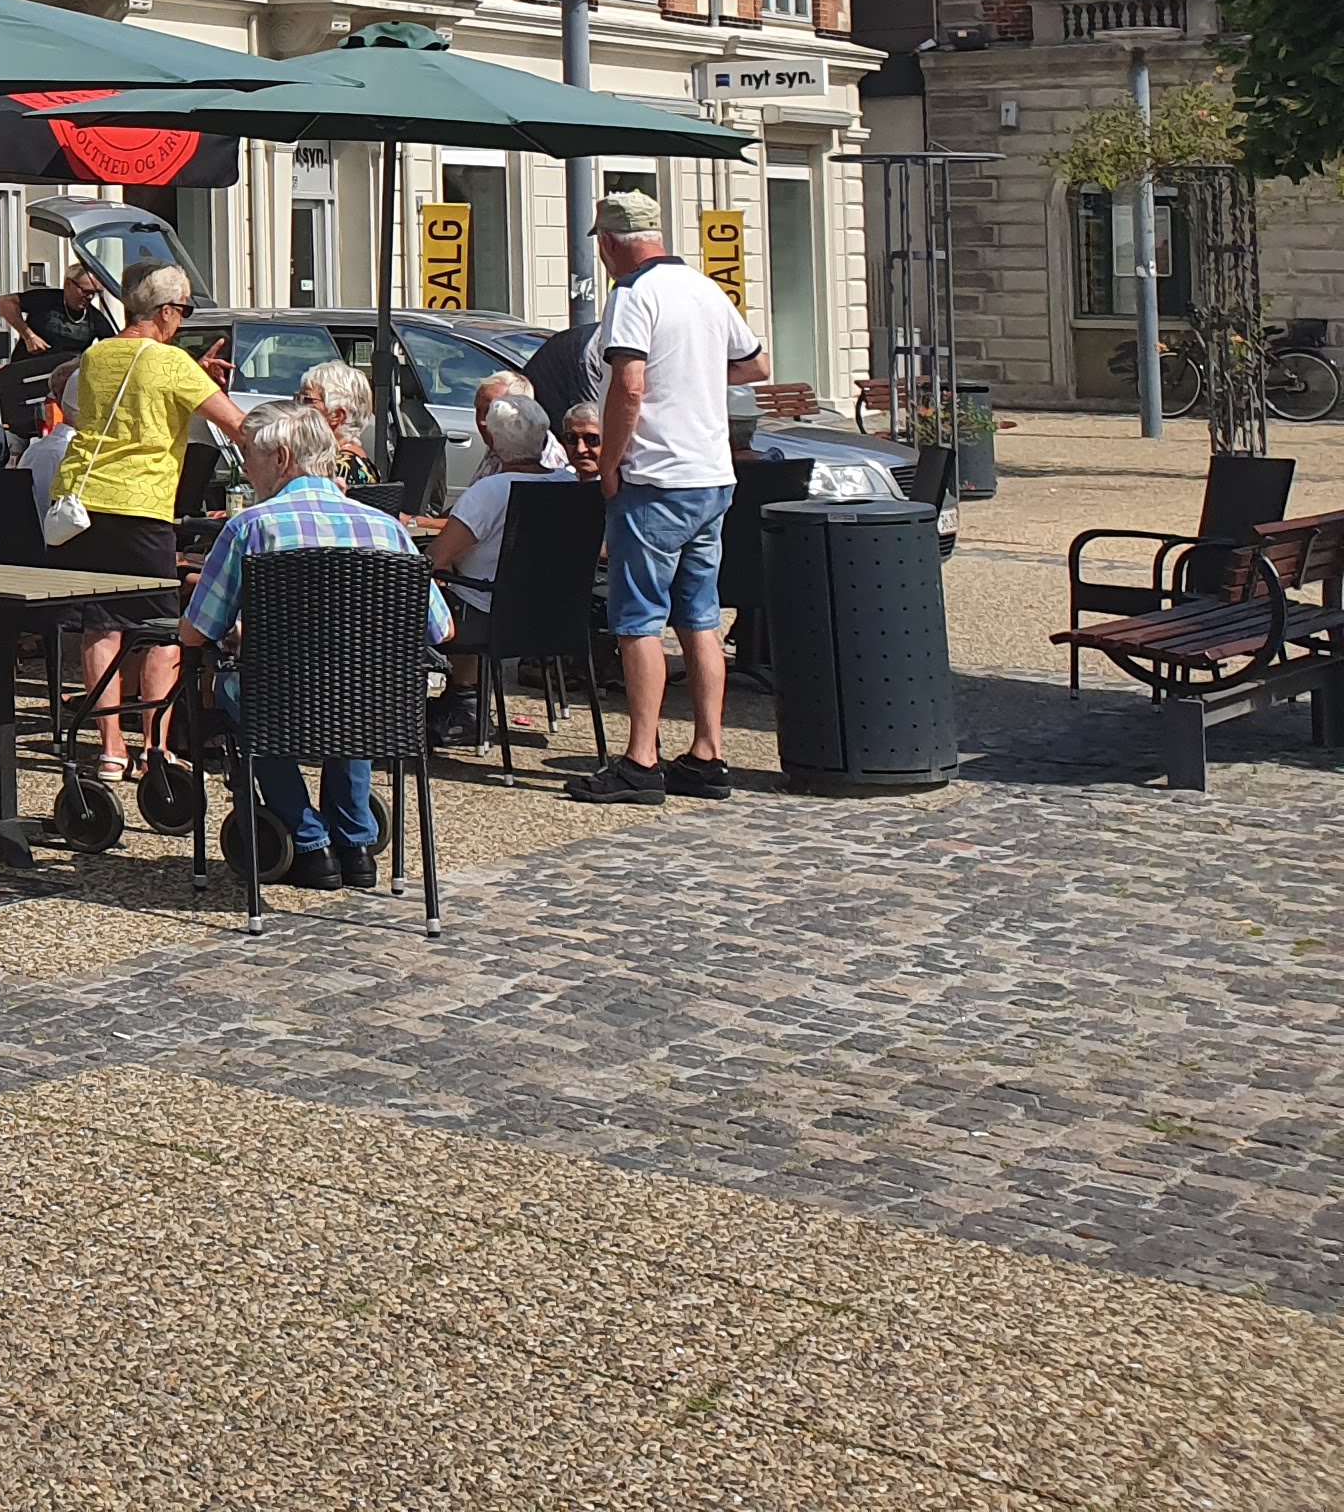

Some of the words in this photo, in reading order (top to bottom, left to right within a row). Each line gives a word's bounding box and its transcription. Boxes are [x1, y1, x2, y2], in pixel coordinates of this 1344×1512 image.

[740, 69, 771, 90] nyt
[775, 71, 816, 89] syn.
[134, 153, 156, 174] OG
